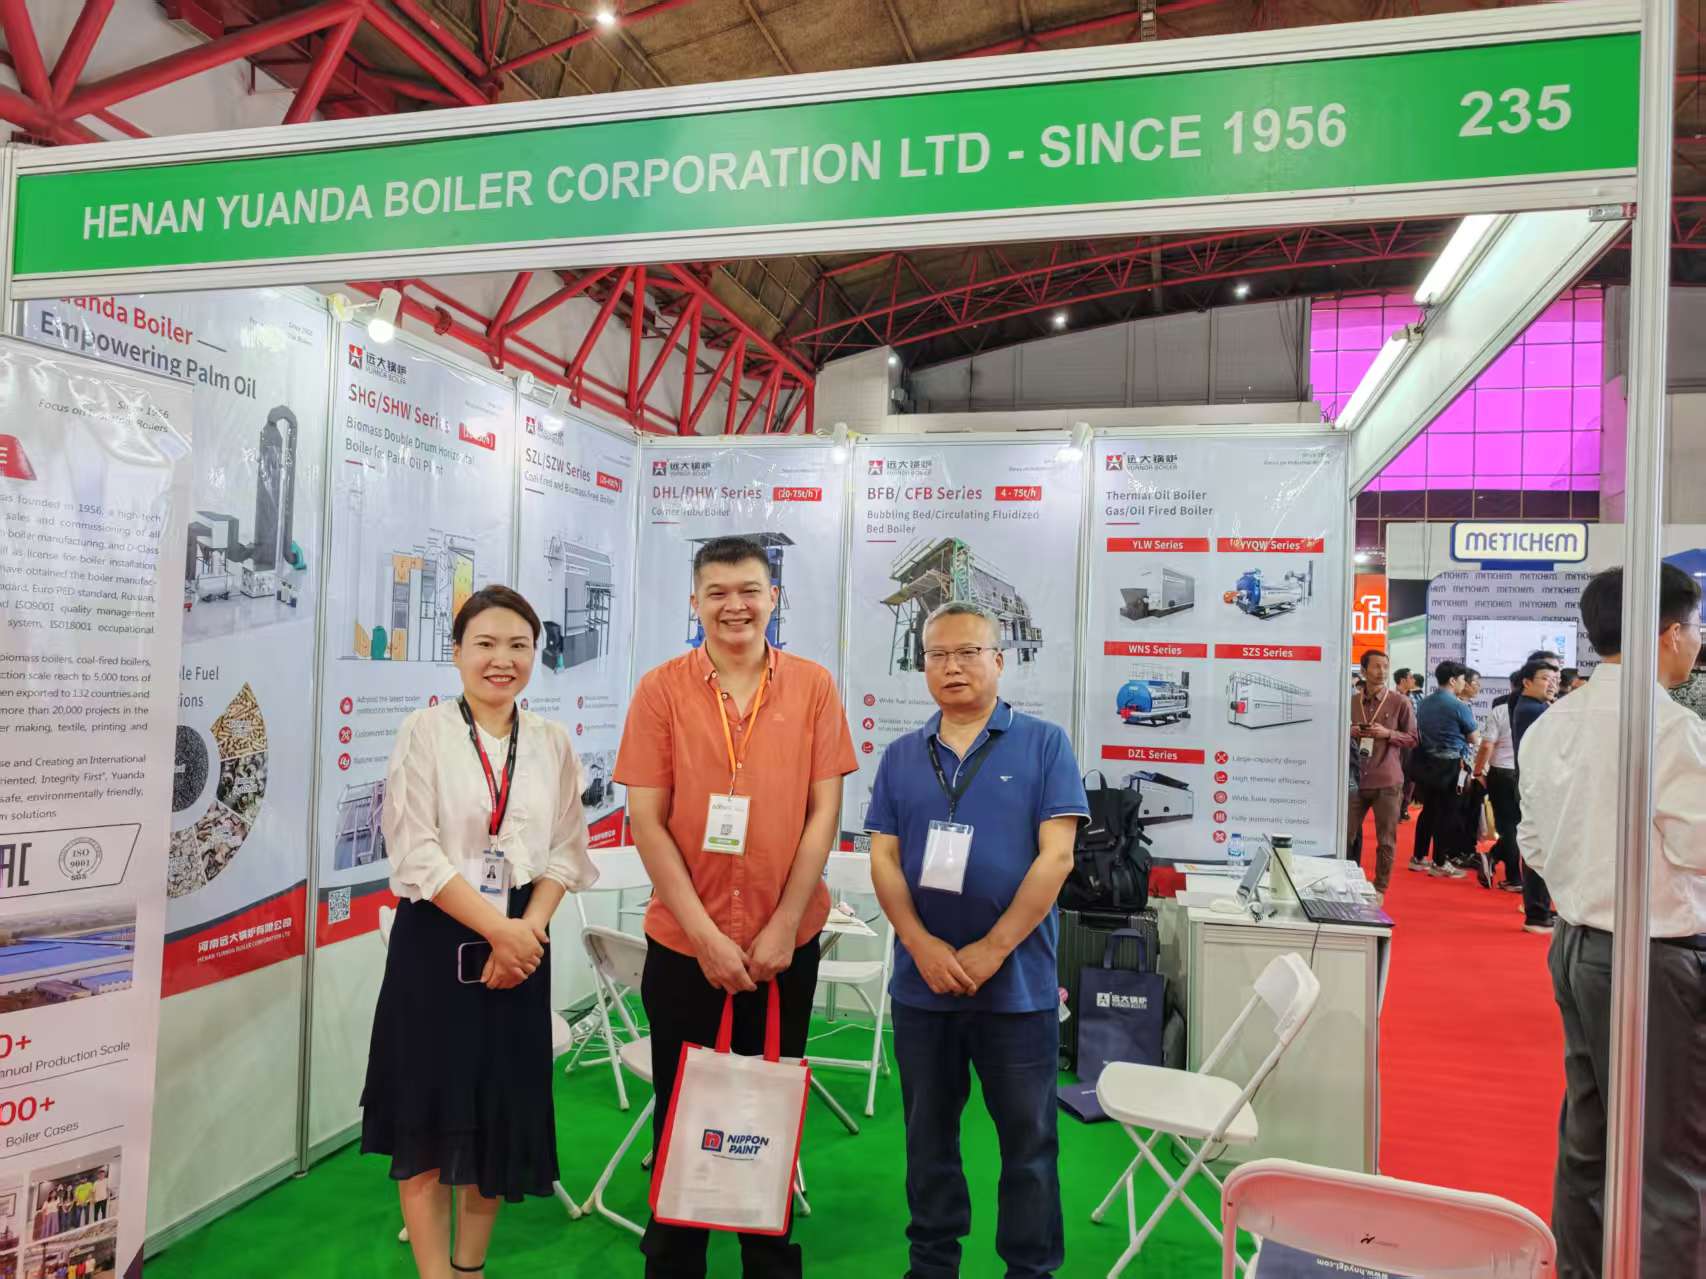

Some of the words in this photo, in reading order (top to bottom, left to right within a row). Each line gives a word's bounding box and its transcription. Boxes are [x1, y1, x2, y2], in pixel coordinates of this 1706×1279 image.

[1459, 84, 1572, 137] 235
[83, 198, 205, 240] HENAN
[217, 184, 373, 229] YUANDA
[384, 170, 534, 217] BOILER
[547, 141, 882, 204] CORPORATION
[901, 132, 990, 178] LTD
[1008, 150, 1024, 160] -
[1040, 114, 1201, 168] SINCE
[1223, 104, 1346, 155] 1956
[134, 307, 192, 344] Boiler
[41, 310, 182, 375] Empowering
[186, 359, 229, 391] Palm
[234, 375, 257, 400] Oil
[349, 384, 411, 420] SHG/SHW
[72, 408, 86, 416] on
[347, 416, 383, 438] Biomass
[385, 428, 413, 447] Double
[415, 438, 437, 453] Drum
[345, 438, 373, 454] Boiler
[409, 457, 421, 469] Oil
[526, 448, 564, 473] SZL/SZW
[566, 462, 591, 482] Series
[653, 486, 717, 500] DHL/DHW
[721, 486, 763, 499] Series
[867, 486, 900, 502] BFB/
[905, 487, 933, 500] CFB
[937, 486, 983, 500] Series
[1001, 489, 1006, 497] 4
[1013, 489, 1036, 498] 75t/h
[1154, 490, 1171, 500] Oil
[1173, 490, 1207, 500] Boiler
[18, 494, 60, 509] founded
[867, 510, 910, 521] Bubbling
[912, 510, 990, 521] Bed/Circulating
[993, 510, 1040, 520] Fluidized
[1105, 505, 1145, 517] Gas/Oil
[1148, 505, 1176, 516] Fired
[1180, 506, 1213, 516] Boiler
[6, 512, 30, 522] sales
[60, 520, 131, 537] commissioning
[136, 528, 146, 536] of
[149, 530, 160, 539] all
[867, 524, 884, 533] Bed
[887, 524, 916, 534] Boiler
[8, 529, 34, 540] boiler
[110, 541, 125, 551] and
[127, 544, 159, 555] D-Class
[1132, 541, 1152, 550] YLW
[1154, 541, 1184, 550] Series
[1271, 540, 1300, 550] Series
[1465, 532, 1578, 553] METICHEM
[27, 549, 58, 560] license
[63, 552, 76, 561] for
[80, 555, 105, 565] boiler
[0, 565, 23, 574] have
[26, 567, 68, 578] obtained
[70, 569, 85, 580] the
[88, 571, 113, 582] boiler
[116, 574, 156, 586] manufac-
[32, 584, 54, 593] Euro
[57, 585, 74, 596] PED
[77, 588, 118, 600] standard,
[15, 601, 54, 611] ISO9001
[60, 604, 92, 615] quality
[97, 607, 155, 618] management
[8, 619, 42, 630] system,
[50, 621, 91, 631] ISO18001
[98, 623, 154, 634] occupational
[1128, 645, 1151, 654] WNS
[1153, 645, 1182, 655] Series
[1242, 647, 1261, 657] SZS
[1263, 648, 1293, 658] Series
[76, 655, 118, 665] coal-fired
[121, 657, 151, 666] boilers,
[29, 672, 51, 680] scale
[54, 672, 79, 680] reach
[82, 673, 91, 681] to
[120, 673, 139, 682] tons
[141, 673, 151, 682] of
[196, 666, 218, 680] Fuel
[16, 689, 59, 699] exported
[91, 690, 131, 698] countries
[133, 690, 150, 698] and
[28, 706, 49, 714] than
[85, 706, 120, 716] projects
[123, 706, 131, 714] in
[135, 706, 149, 714] the
[15, 723, 53, 734] making,
[58, 723, 87, 732] textile,
[92, 723, 126, 733] printing
[131, 723, 148, 731] and
[14, 758, 32, 768] and
[35, 757, 74, 767] Creating
[77, 758, 88, 766] an
[91, 755, 146, 764] International
[1128, 750, 1145, 759] DZL
[1149, 751, 1178, 761] Series
[42, 774, 80, 785] Integrity
[112, 771, 145, 780] Yuanda
[27, 790, 104, 801] environmentally
[107, 787, 144, 797] friendly,
[11, 811, 57, 821] solutions
[72, 849, 90, 857] ISO
[70, 860, 90, 868] 9001
[36, 1048, 98, 1072] Production
[100, 1041, 131, 1056] Scale
[6, 1131, 40, 1148] Boiler
[44, 1121, 79, 1138] Cases
[727, 1135, 769, 1145] NIPPON
[729, 1145, 761, 1155] PAINT
